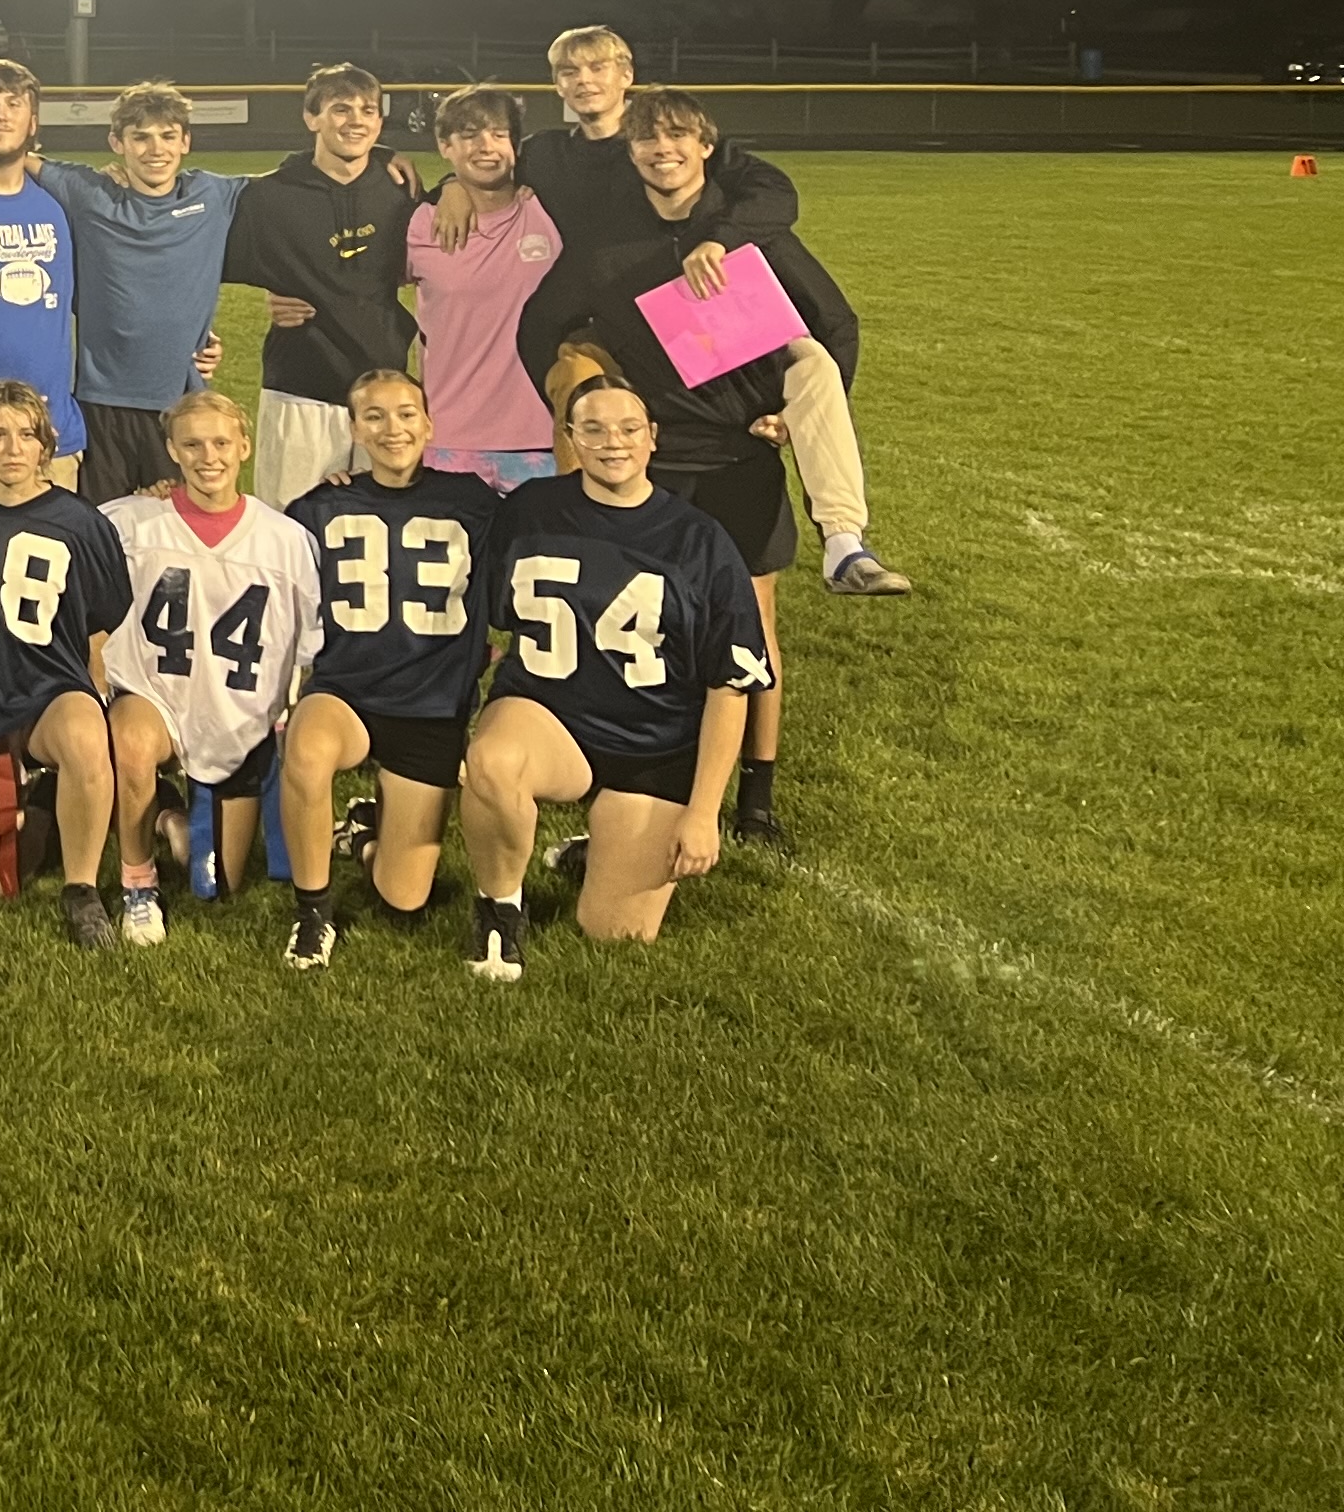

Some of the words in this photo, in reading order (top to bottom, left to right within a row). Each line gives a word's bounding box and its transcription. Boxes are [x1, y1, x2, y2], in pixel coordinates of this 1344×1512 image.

[28, 223, 58, 245] LAKE
[141, 567, 270, 690] 44
[324, 514, 471, 636] 33
[511, 555, 666, 688] 54
